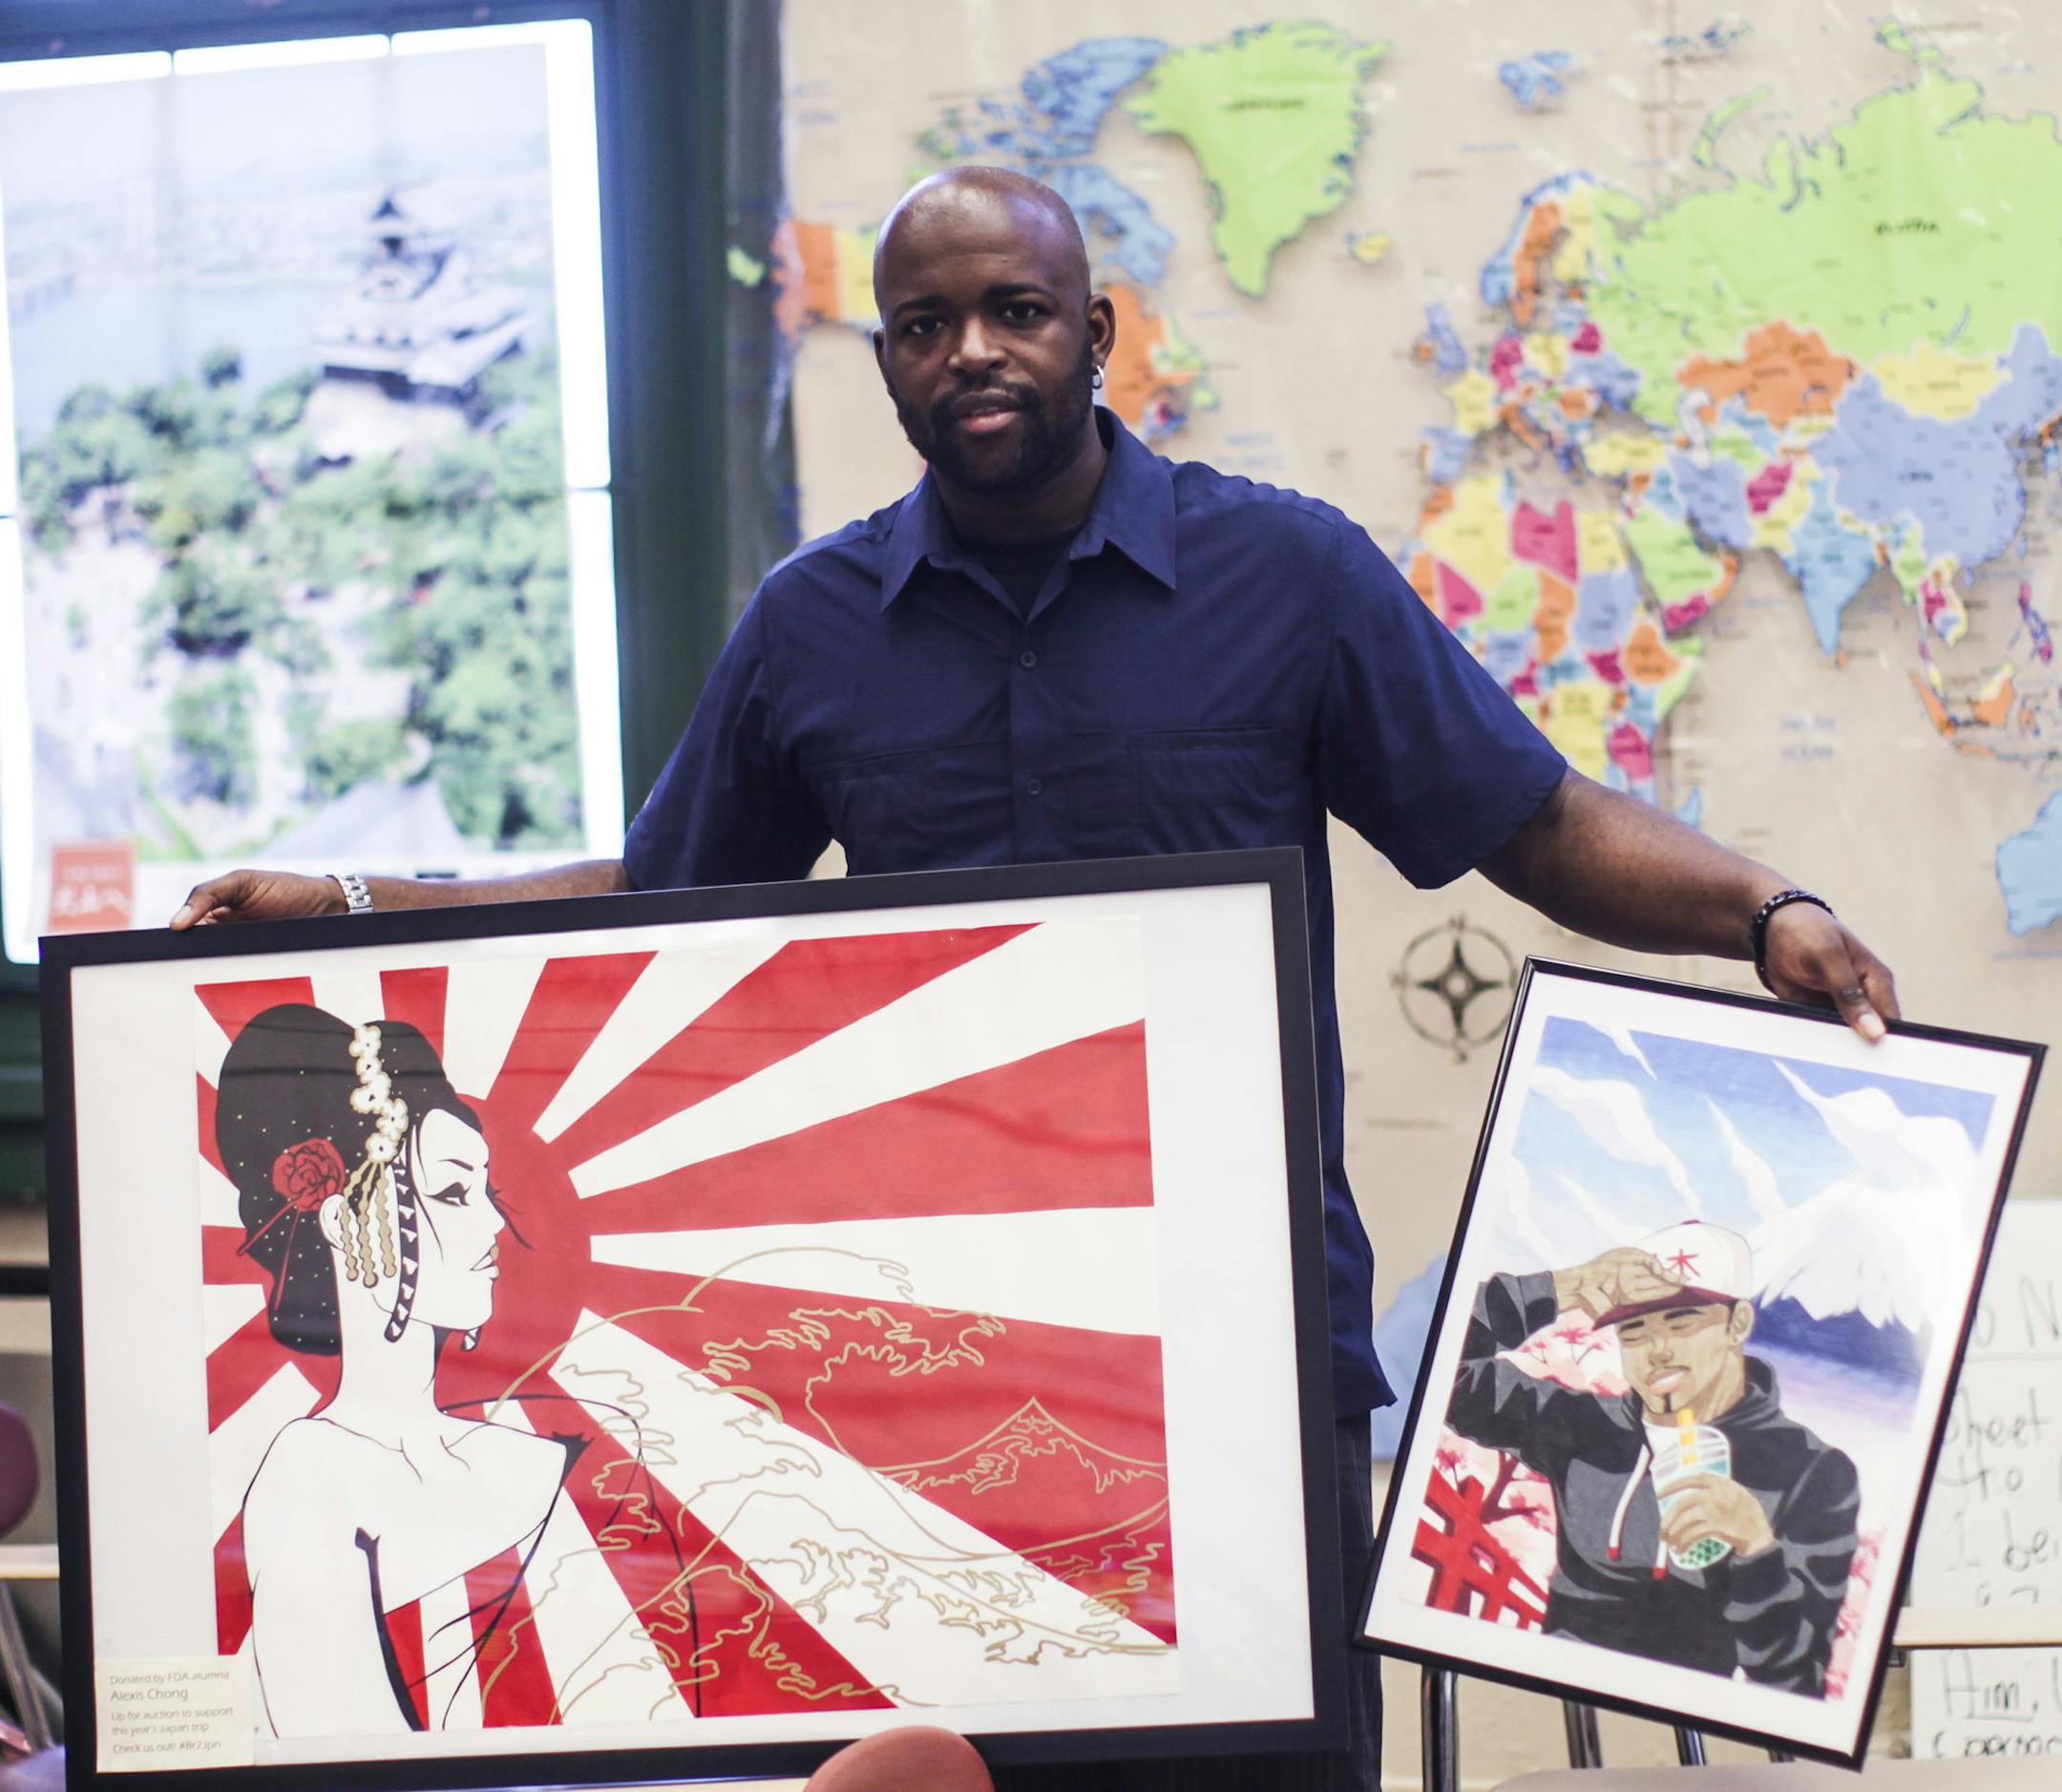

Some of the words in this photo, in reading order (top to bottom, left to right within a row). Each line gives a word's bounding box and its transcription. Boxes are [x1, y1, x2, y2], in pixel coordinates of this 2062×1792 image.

[109, 1675, 152, 1686] Donated
[153, 1674, 165, 1685] by
[110, 1689, 144, 1702] Alexis
[147, 1687, 189, 1702] Chong
[111, 1711, 126, 1722] Up
[127, 1710, 140, 1720] for
[143, 1709, 179, 1719] auction
[181, 1709, 193, 1718] to
[195, 1706, 234, 1719] support
[112, 1726, 128, 1736] this
[159, 1724, 190, 1736] Japan
[192, 1722, 209, 1733] trip
[113, 1743, 140, 1754] Check
[143, 1743, 155, 1753] us
